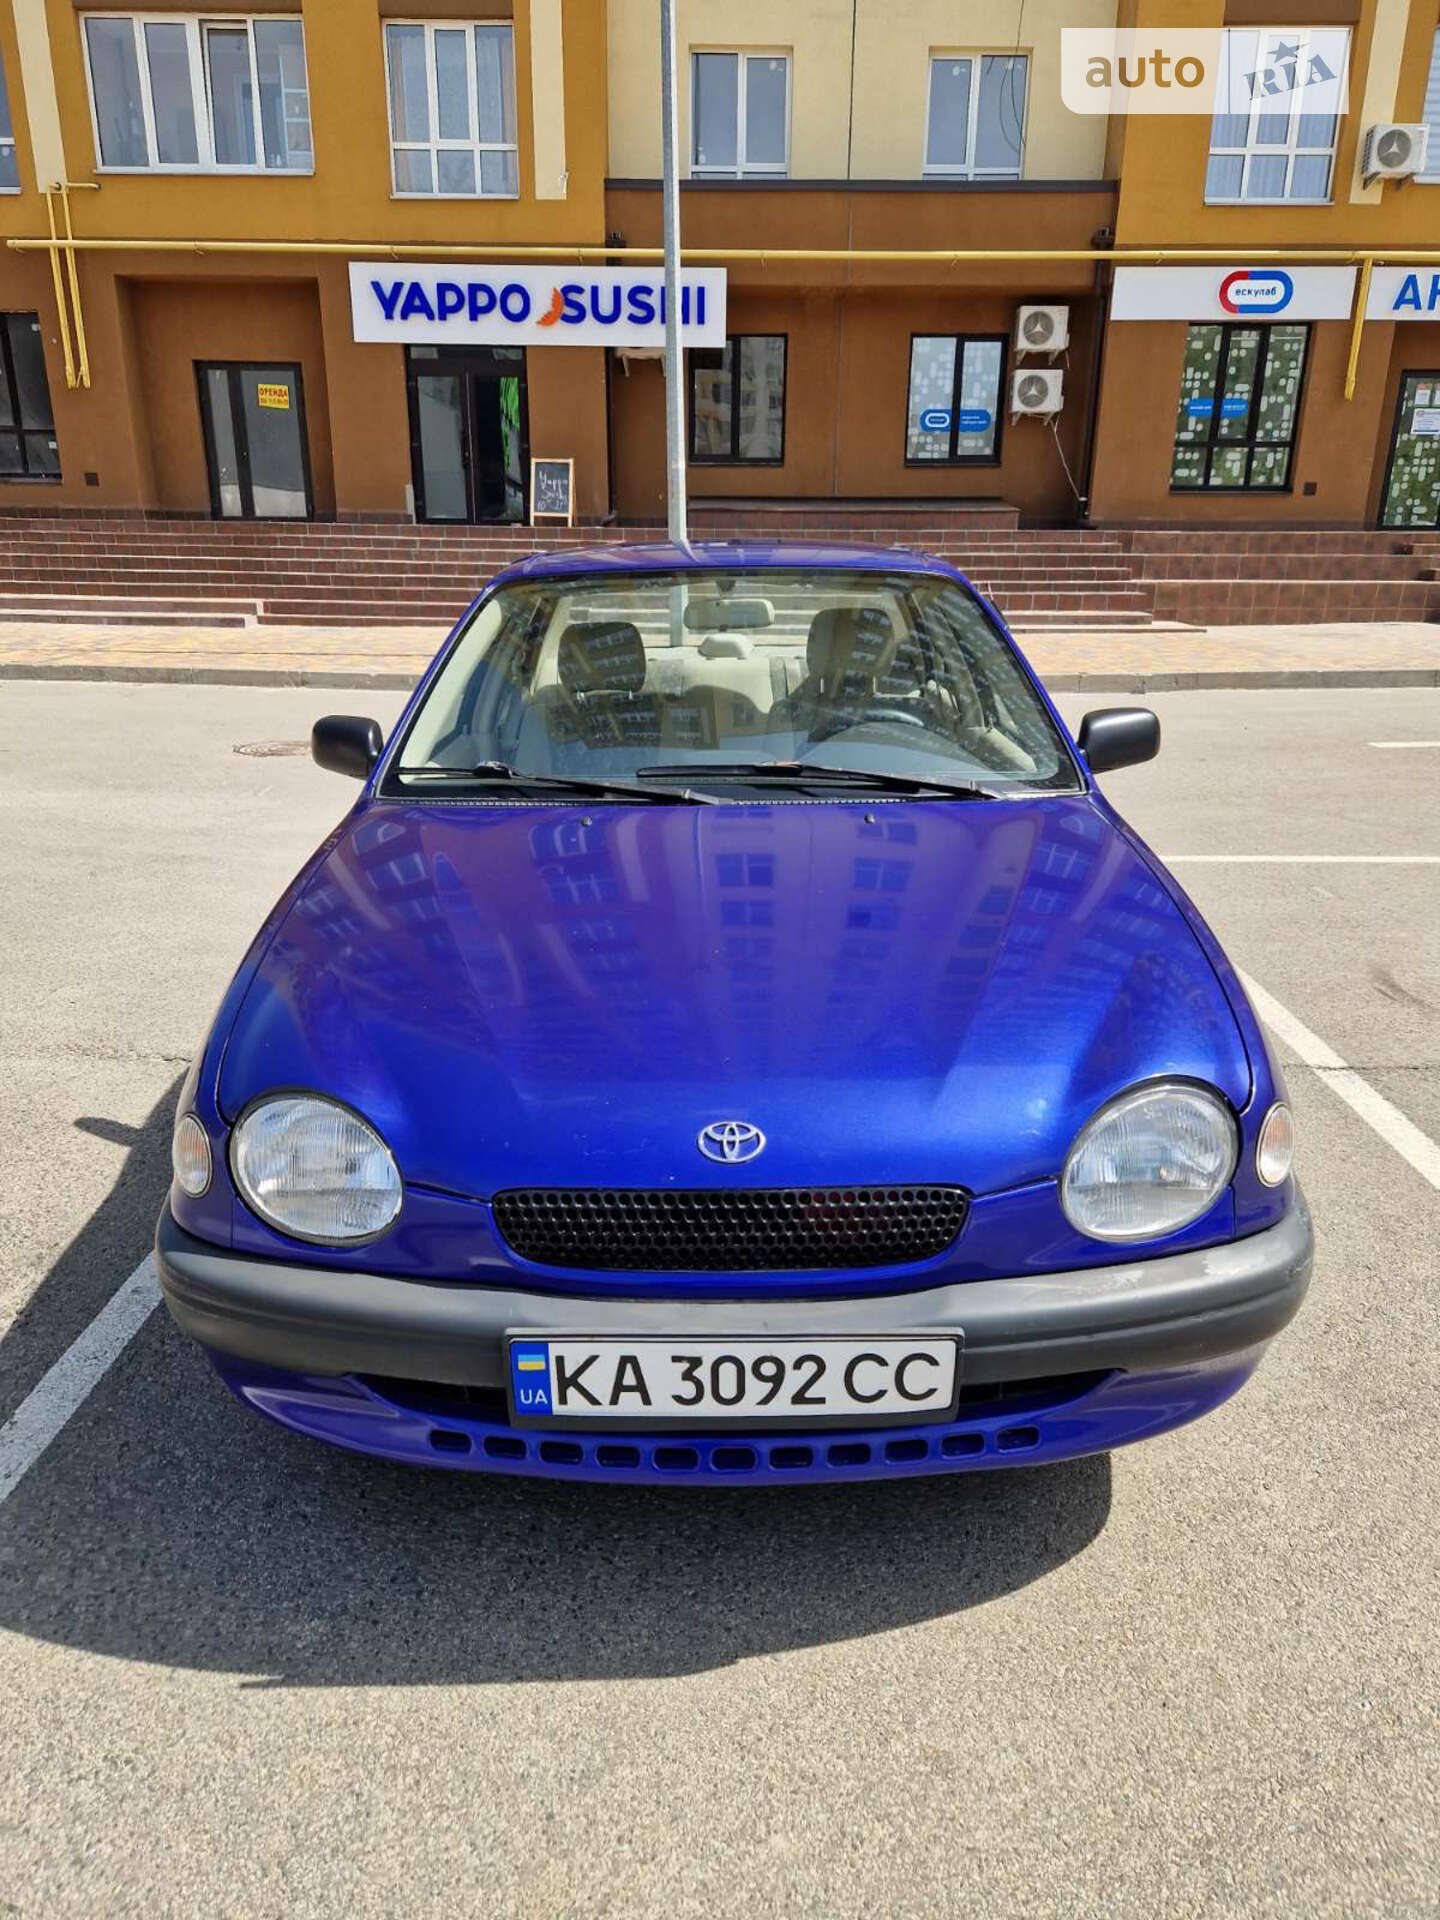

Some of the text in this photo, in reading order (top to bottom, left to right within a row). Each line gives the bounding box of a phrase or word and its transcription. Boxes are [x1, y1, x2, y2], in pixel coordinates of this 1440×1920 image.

[371, 280, 706, 326] YAPPO SUSHI
[1235, 286, 1278, 297] ескулаб
[556, 1353, 940, 1406] KA 3092 CC
[520, 1388, 548, 1405] UA
